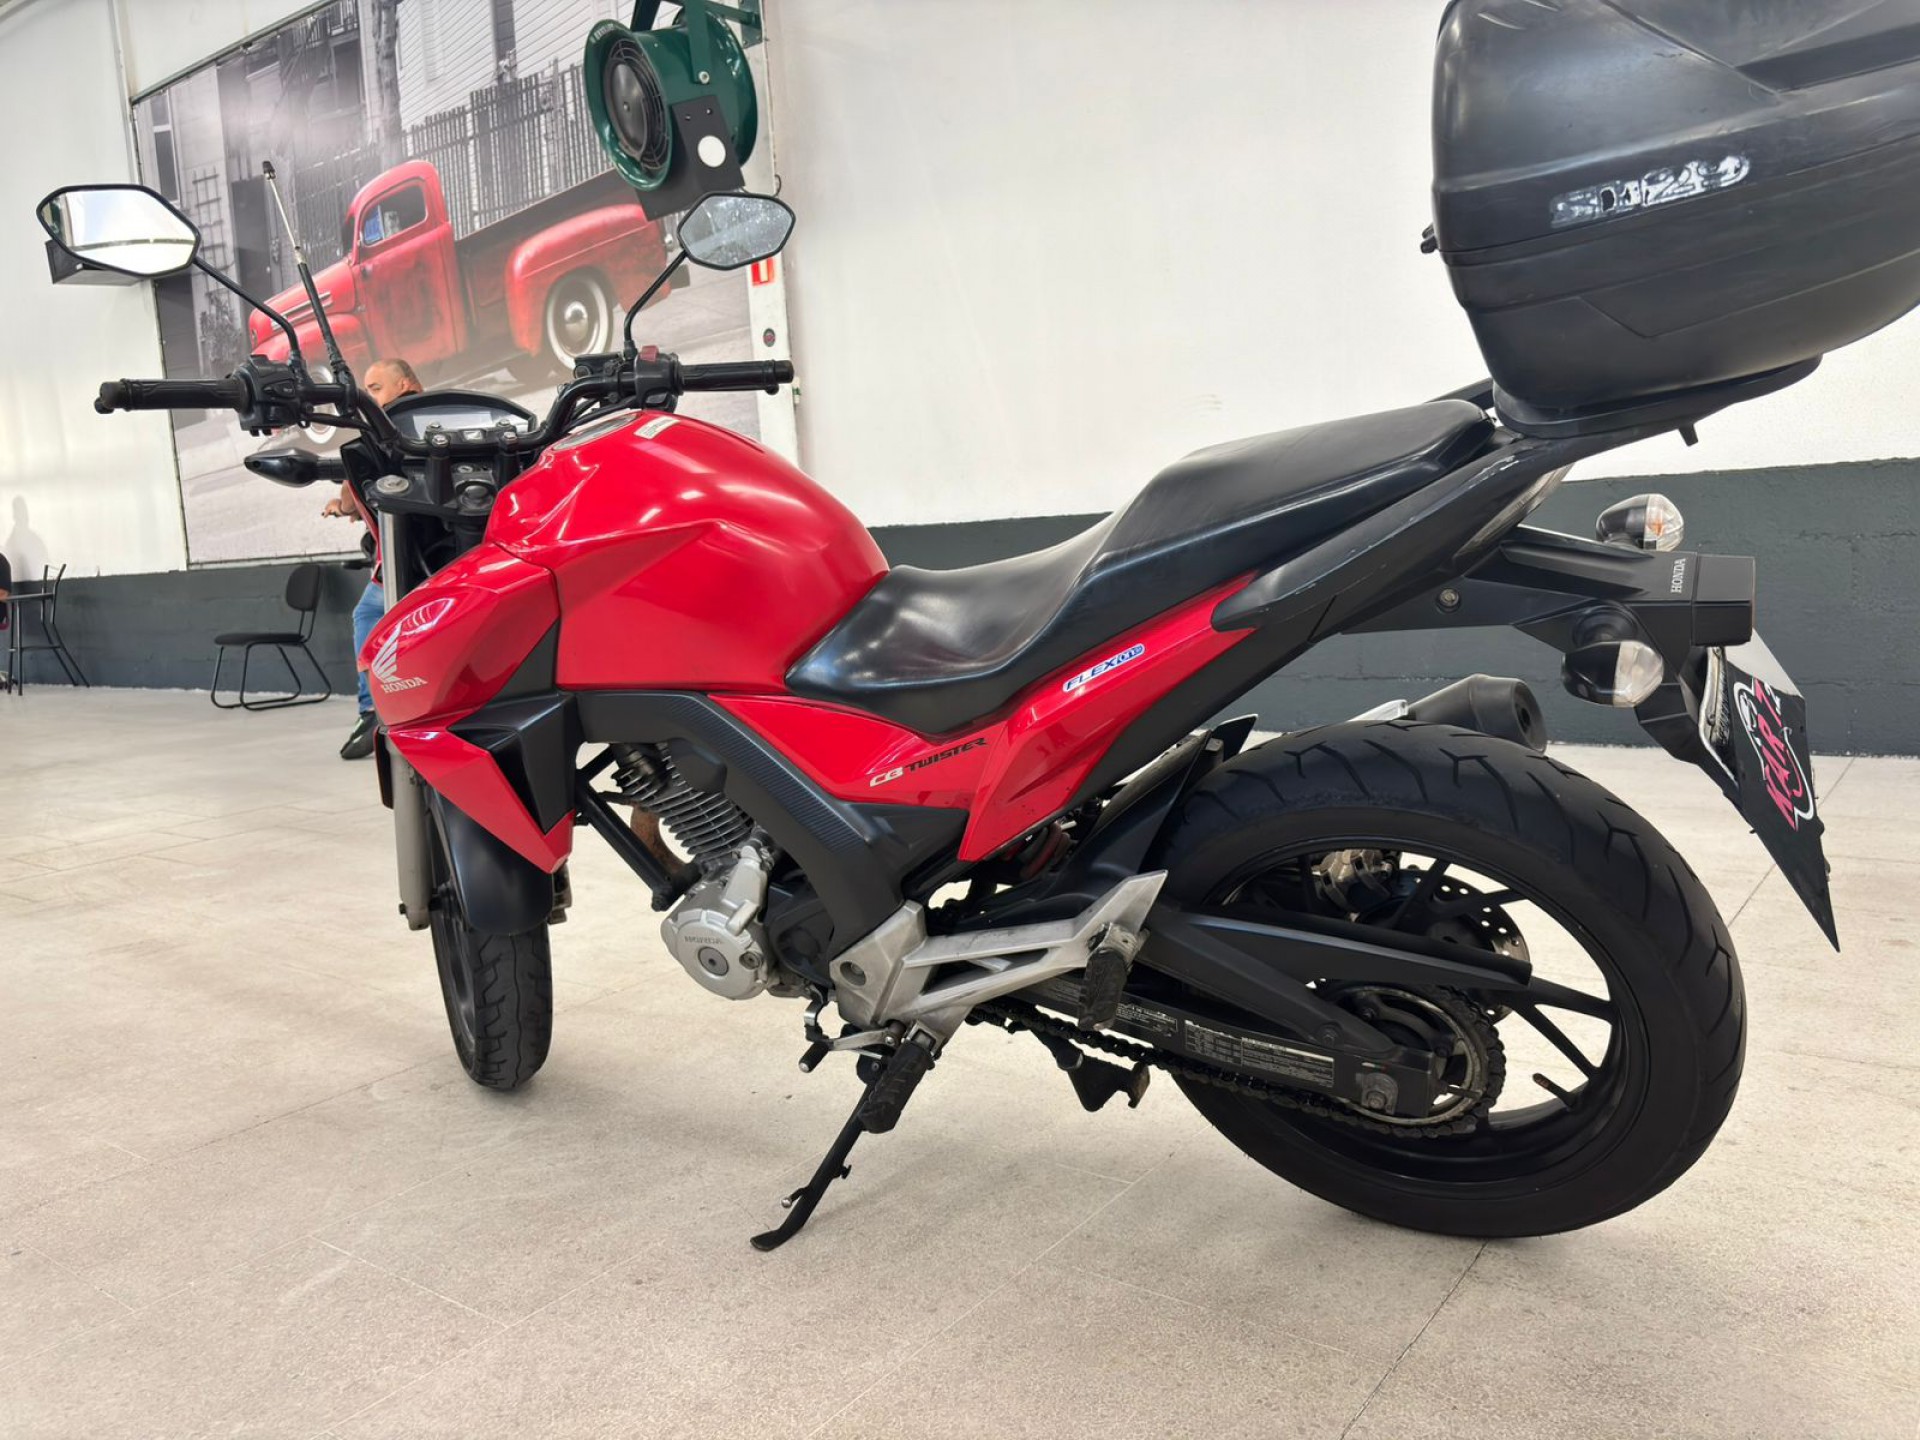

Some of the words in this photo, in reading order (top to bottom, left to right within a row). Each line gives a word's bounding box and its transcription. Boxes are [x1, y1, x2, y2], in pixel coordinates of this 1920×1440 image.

[1671, 558, 1686, 593] HONDA
[382, 677, 428, 693] HONDA
[869, 767, 903, 787] CB
[903, 737, 987, 772] TWISTER
